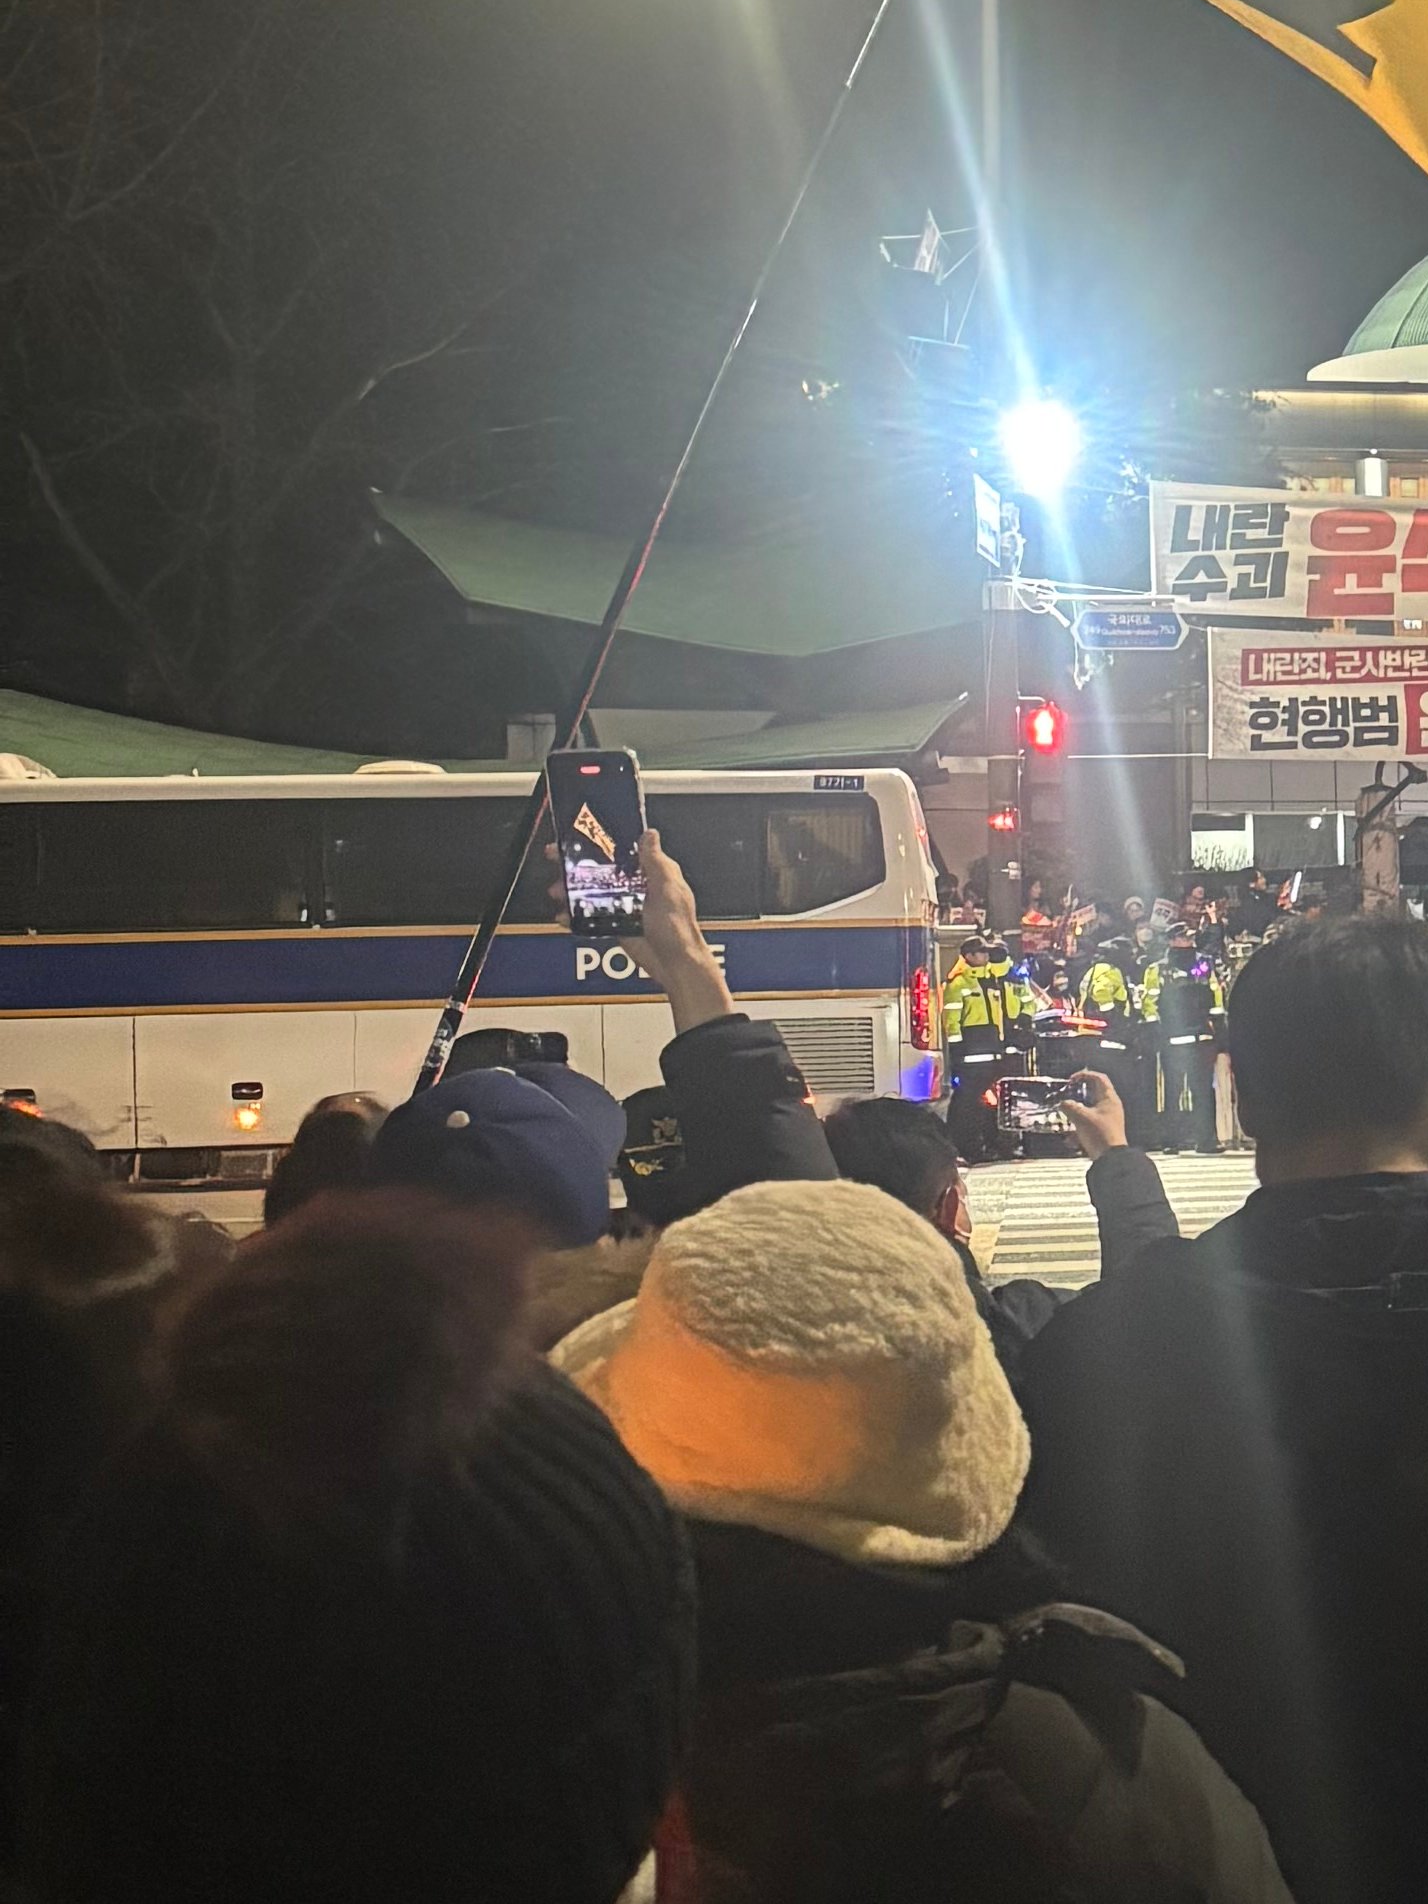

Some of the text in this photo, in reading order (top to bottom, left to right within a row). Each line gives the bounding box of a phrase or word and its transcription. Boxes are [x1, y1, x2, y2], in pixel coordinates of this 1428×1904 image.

[1170, 503, 1290, 553] 내란
[1172, 551, 1289, 602] 수괴
[1248, 650, 1332, 681] 내란죄,
[1248, 694, 1400, 752] 현행범
